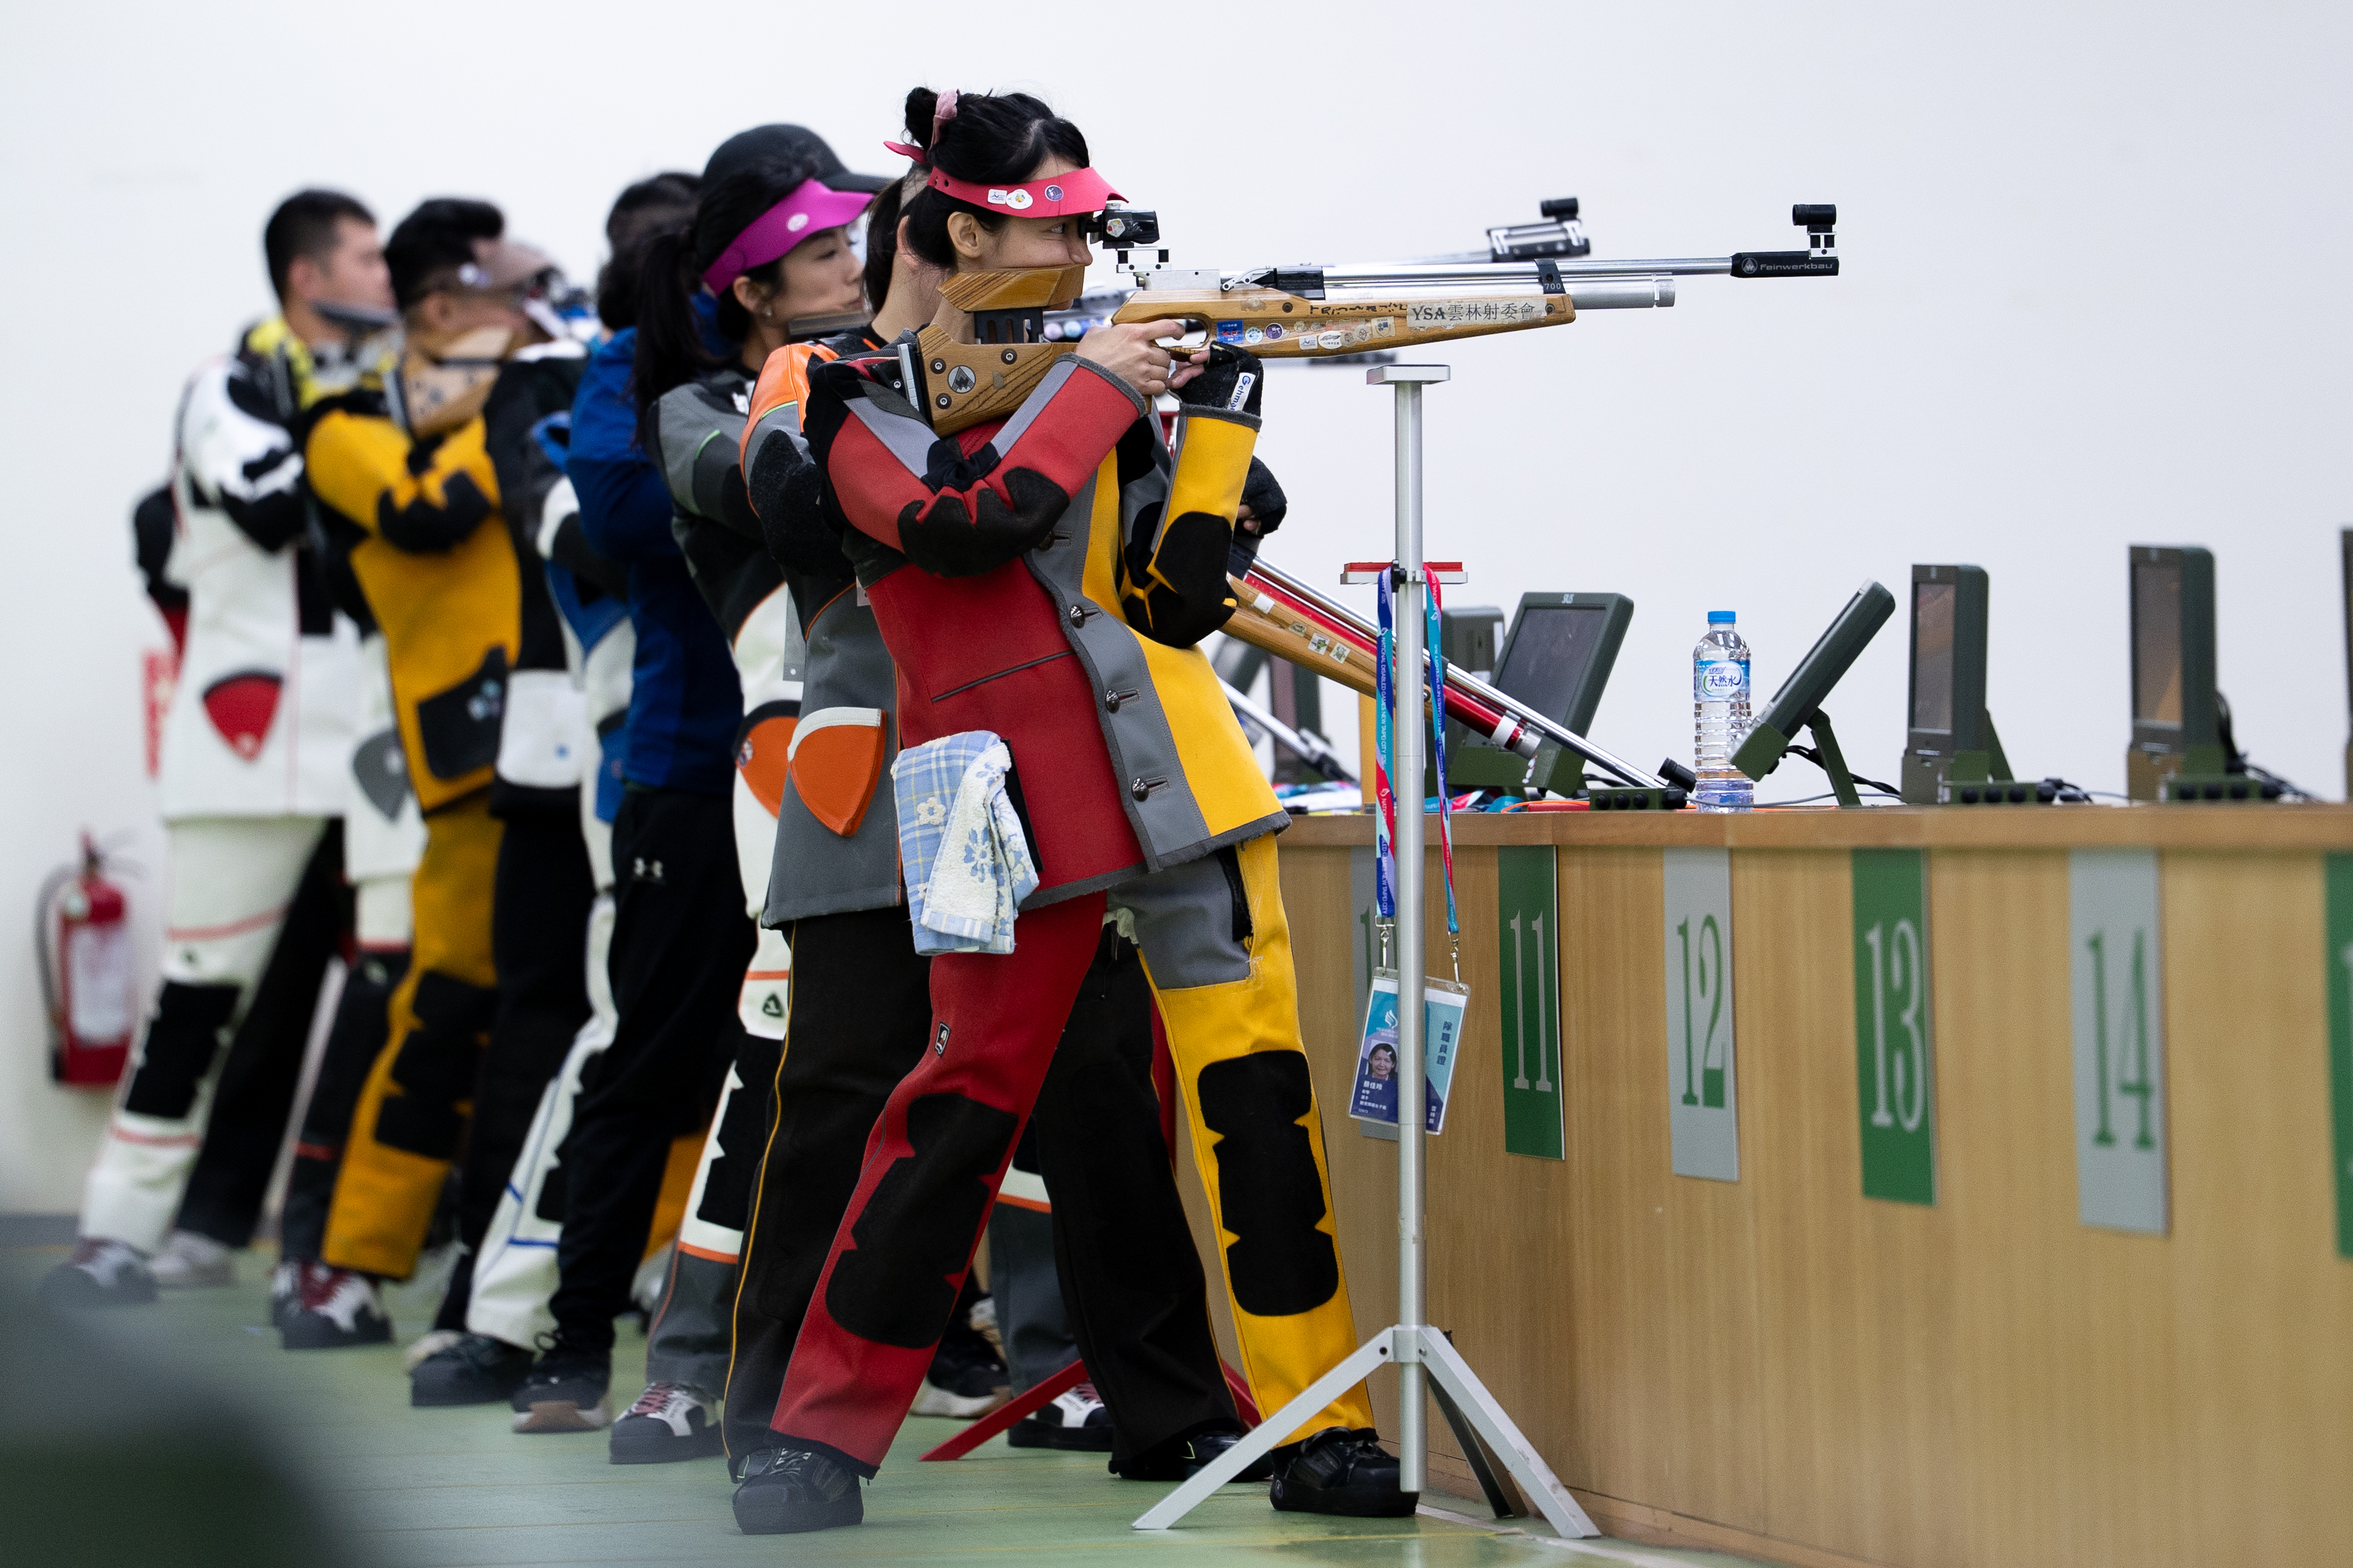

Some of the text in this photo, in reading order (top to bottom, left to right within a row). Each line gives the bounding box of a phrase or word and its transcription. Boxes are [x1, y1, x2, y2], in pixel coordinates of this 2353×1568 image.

[1760, 262, 1833, 271] Feinwerkbau
[1708, 675, 1742, 687] 天然水
[1510, 910, 1552, 1092] 11
[1677, 914, 1727, 1108] 12
[1864, 918, 1925, 1132] 13
[2087, 927, 2157, 1149] 14
